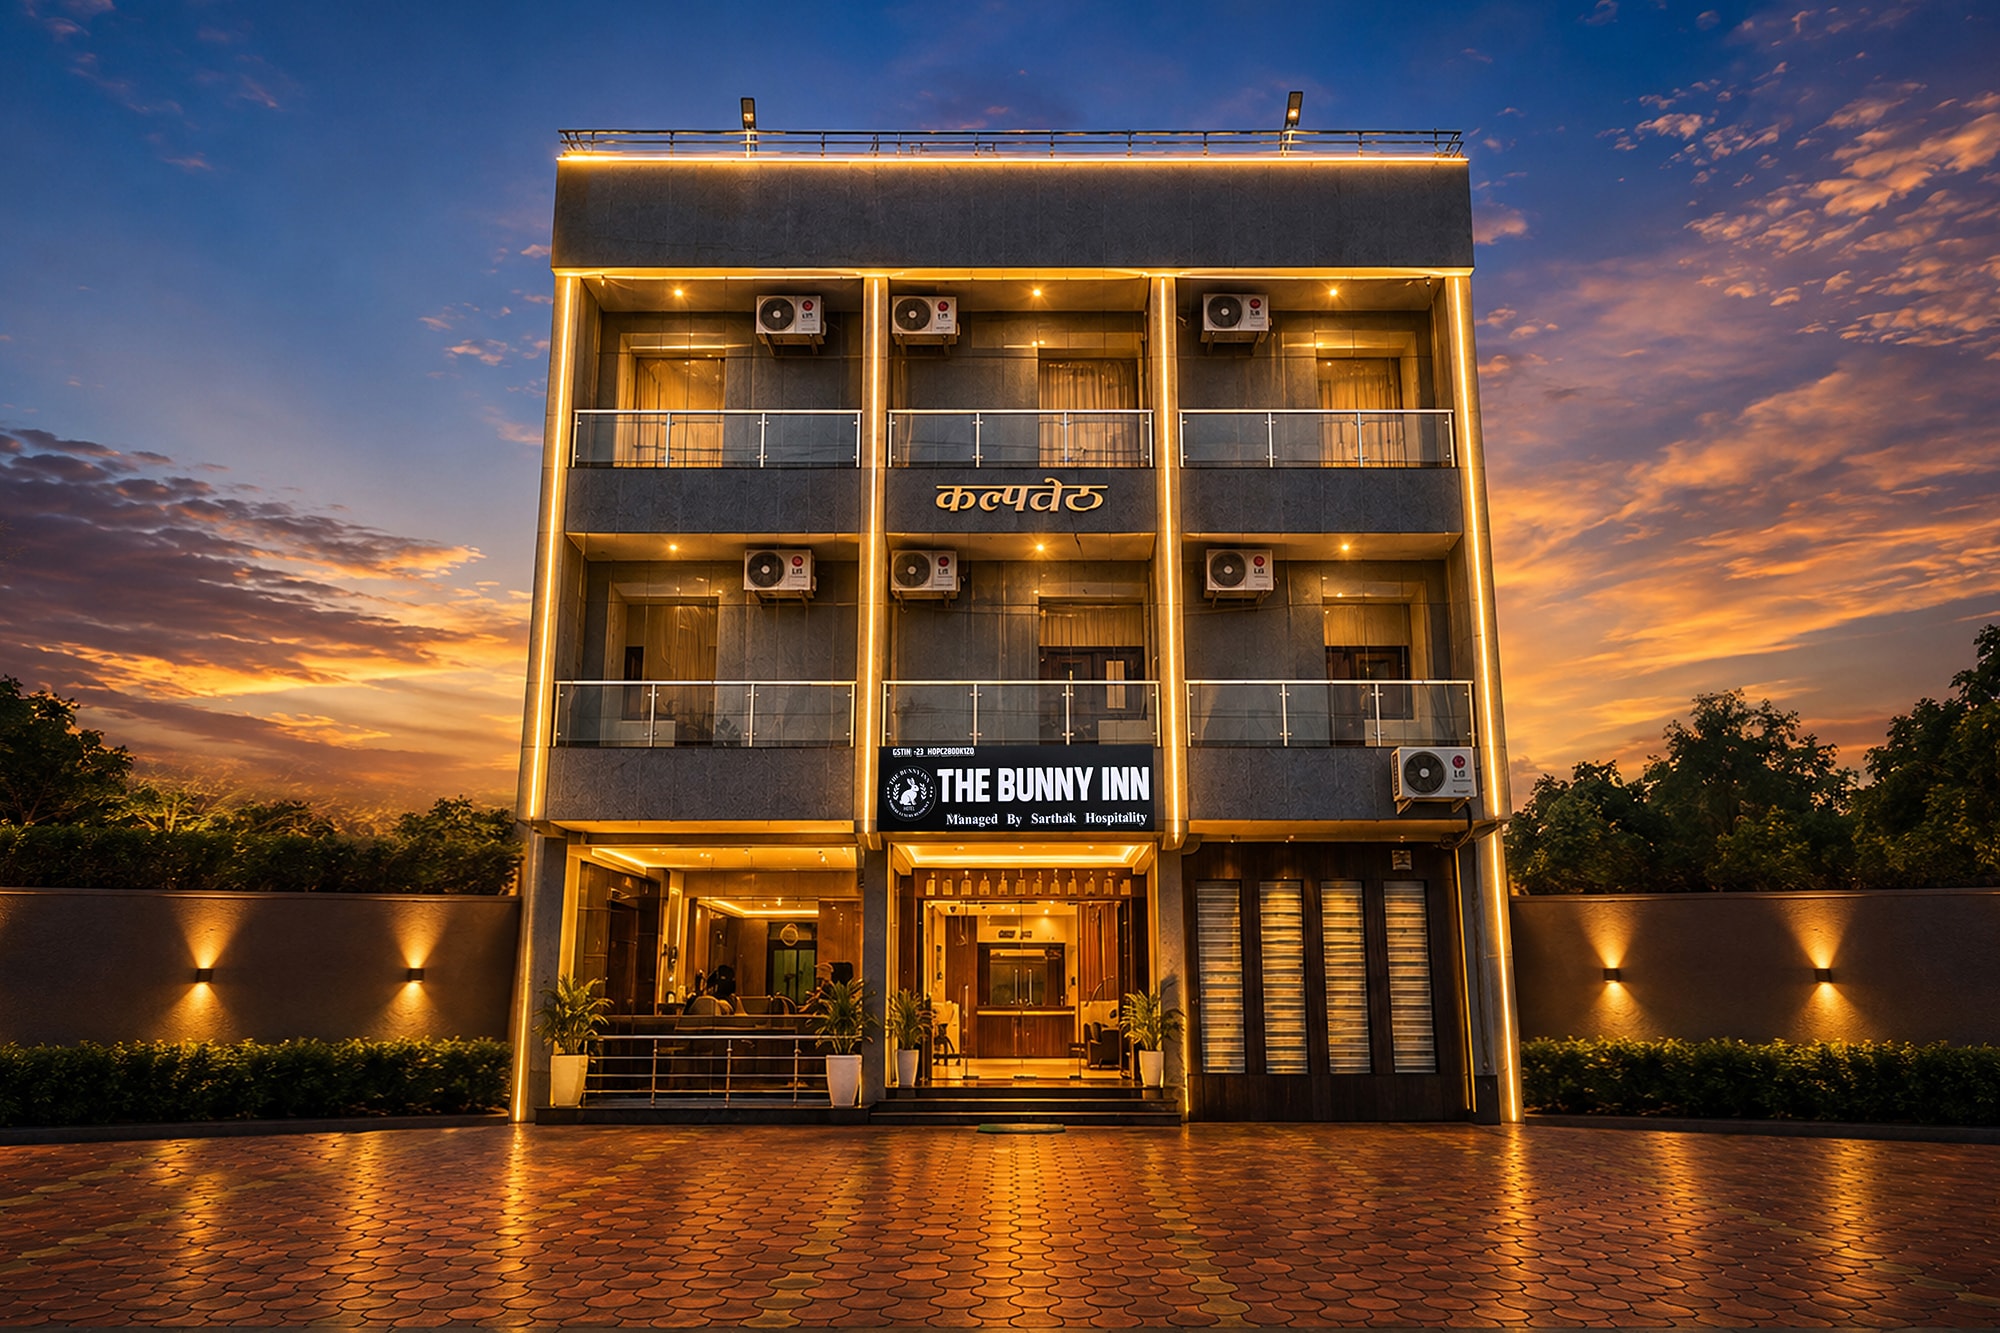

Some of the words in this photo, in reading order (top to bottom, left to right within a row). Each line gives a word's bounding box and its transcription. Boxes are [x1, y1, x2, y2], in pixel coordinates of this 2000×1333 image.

[892, 748, 911, 756] GSTIN
[936, 768, 991, 803] THE
[997, 767, 1094, 802] BUNNY
[1101, 766, 1150, 801] INN
[946, 813, 998, 828] Managed
[1007, 813, 1022, 828] By
[1031, 812, 1077, 825] Sarthak
[1085, 811, 1148, 826] Hospitality
